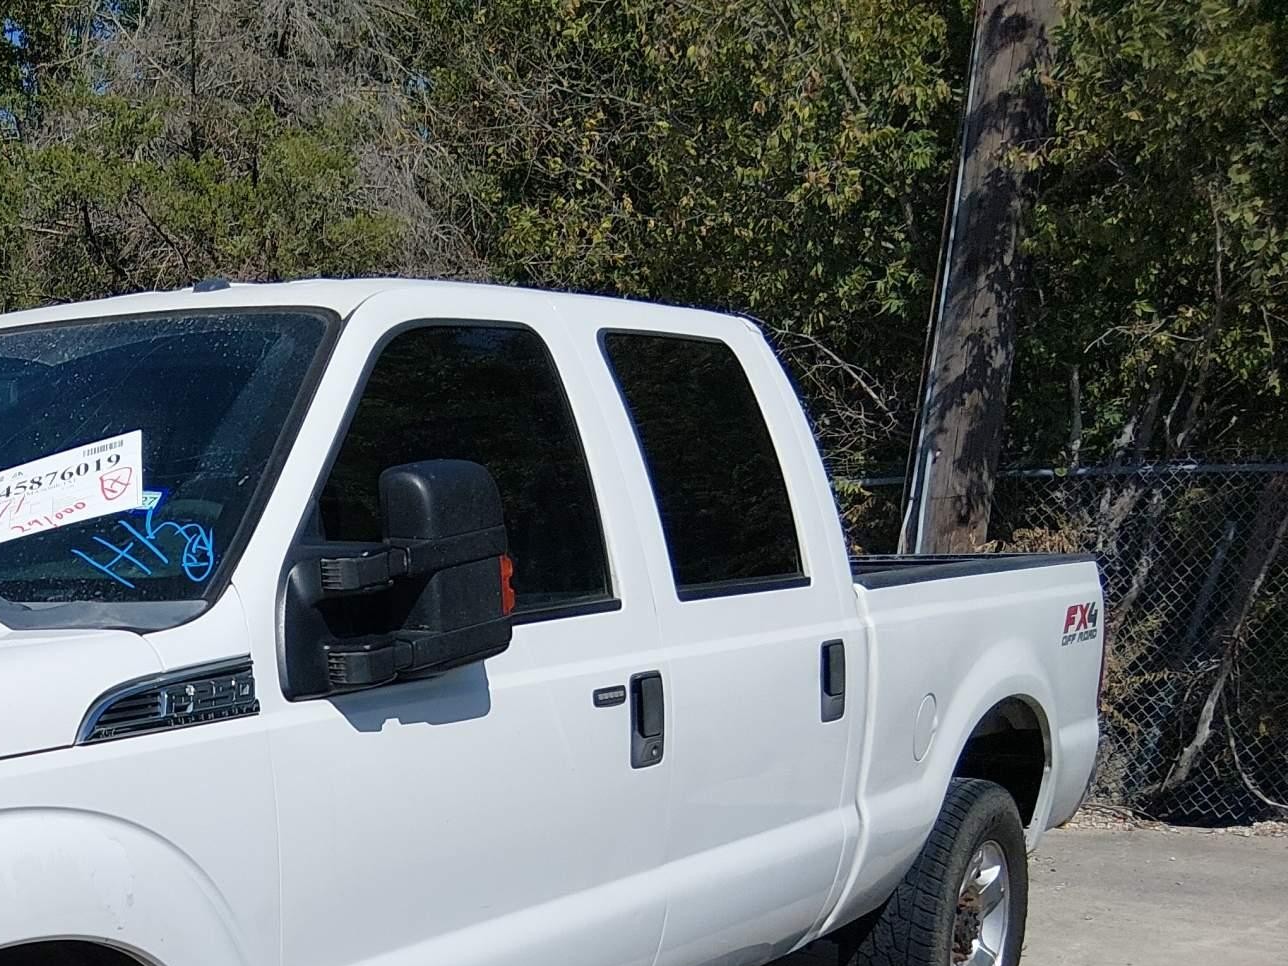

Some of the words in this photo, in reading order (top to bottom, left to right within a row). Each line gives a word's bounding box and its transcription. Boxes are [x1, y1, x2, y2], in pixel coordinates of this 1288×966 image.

[1063, 601, 1098, 634] FX4
[1061, 633, 1077, 646] OFF
[1077, 628, 1097, 642] ROAD
